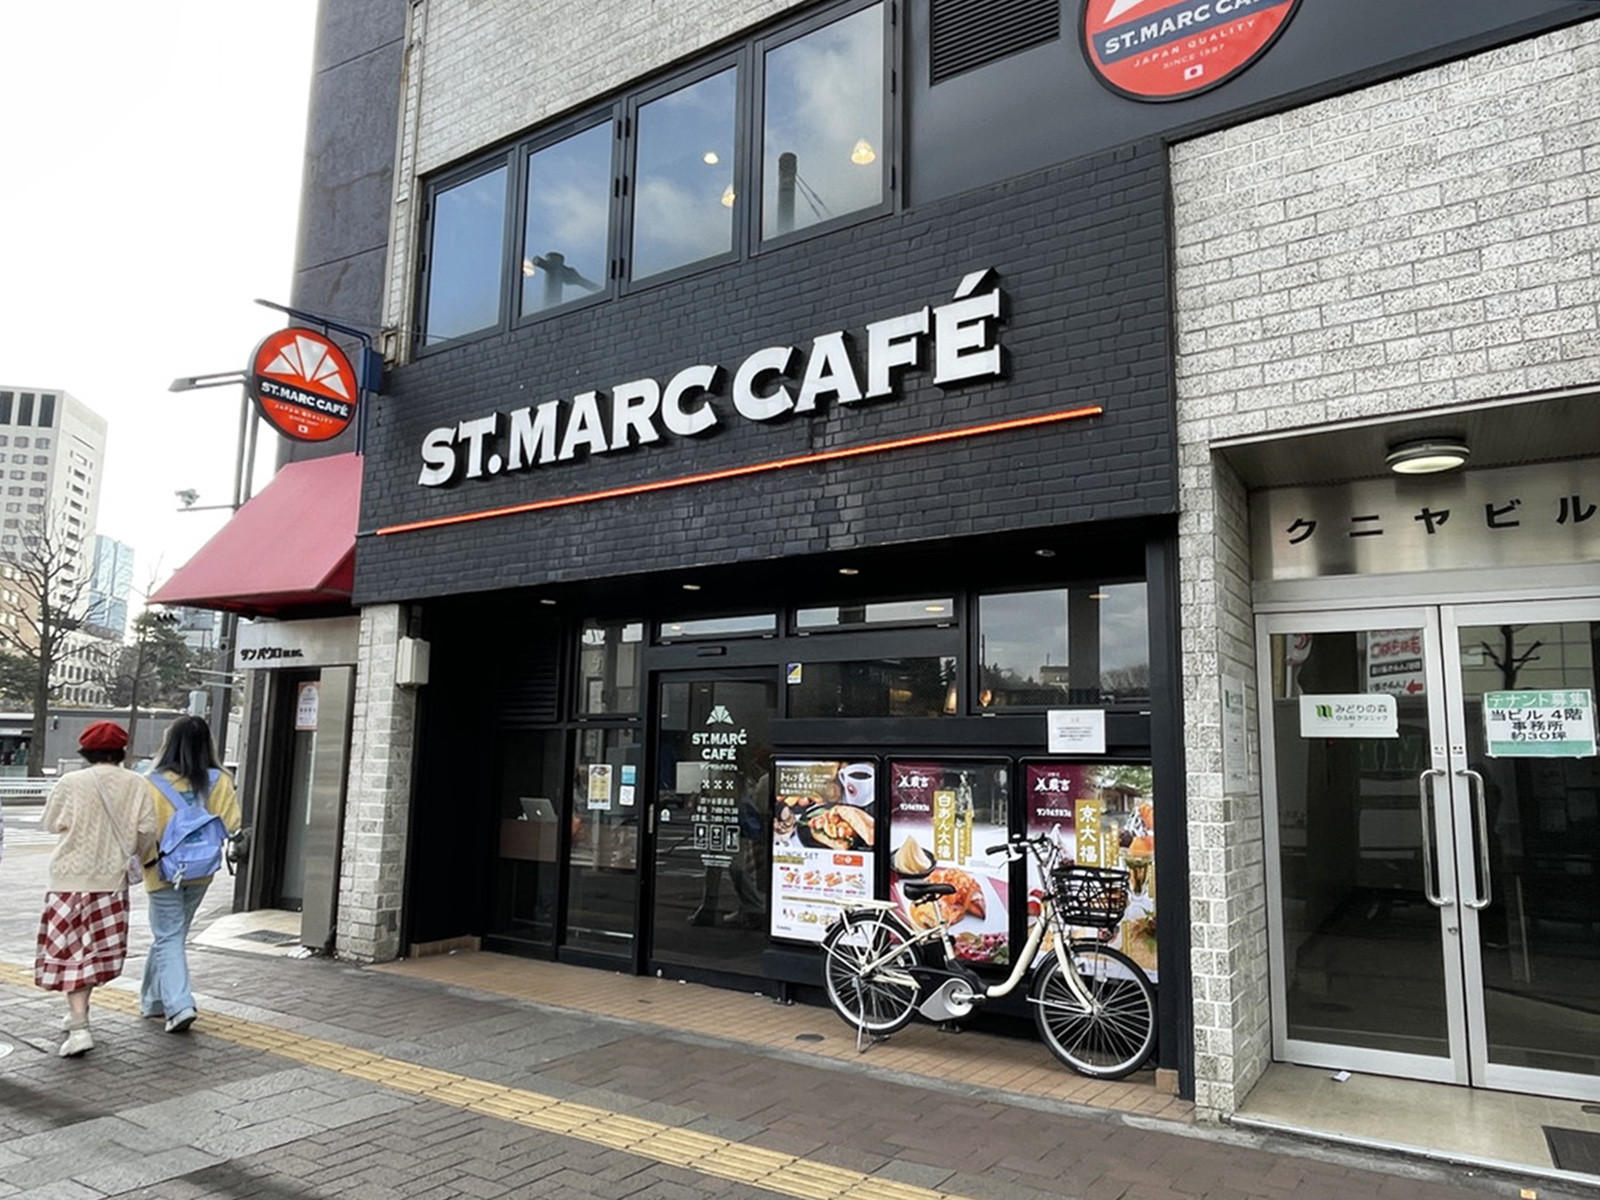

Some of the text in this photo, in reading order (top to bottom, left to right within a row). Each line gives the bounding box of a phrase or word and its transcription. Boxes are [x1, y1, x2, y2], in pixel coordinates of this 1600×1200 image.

[1105, 4, 1211, 55] ST.MARC
[1133, 20, 1255, 68] JAPAN QUALITY
[1162, 53, 1195, 69] SINCE
[418, 267, 1001, 487] ST.MARC CAFÉ
[261, 381, 349, 417] ST.MARC CAFÉ
[1286, 496, 1597, 545] クニヤビル
[1335, 704, 1387, 714] みどりの森
[1511, 731, 1567, 741] 約30坪
[1512, 721, 1563, 731] 事務所
[701, 746, 737, 760] CAFÉ
